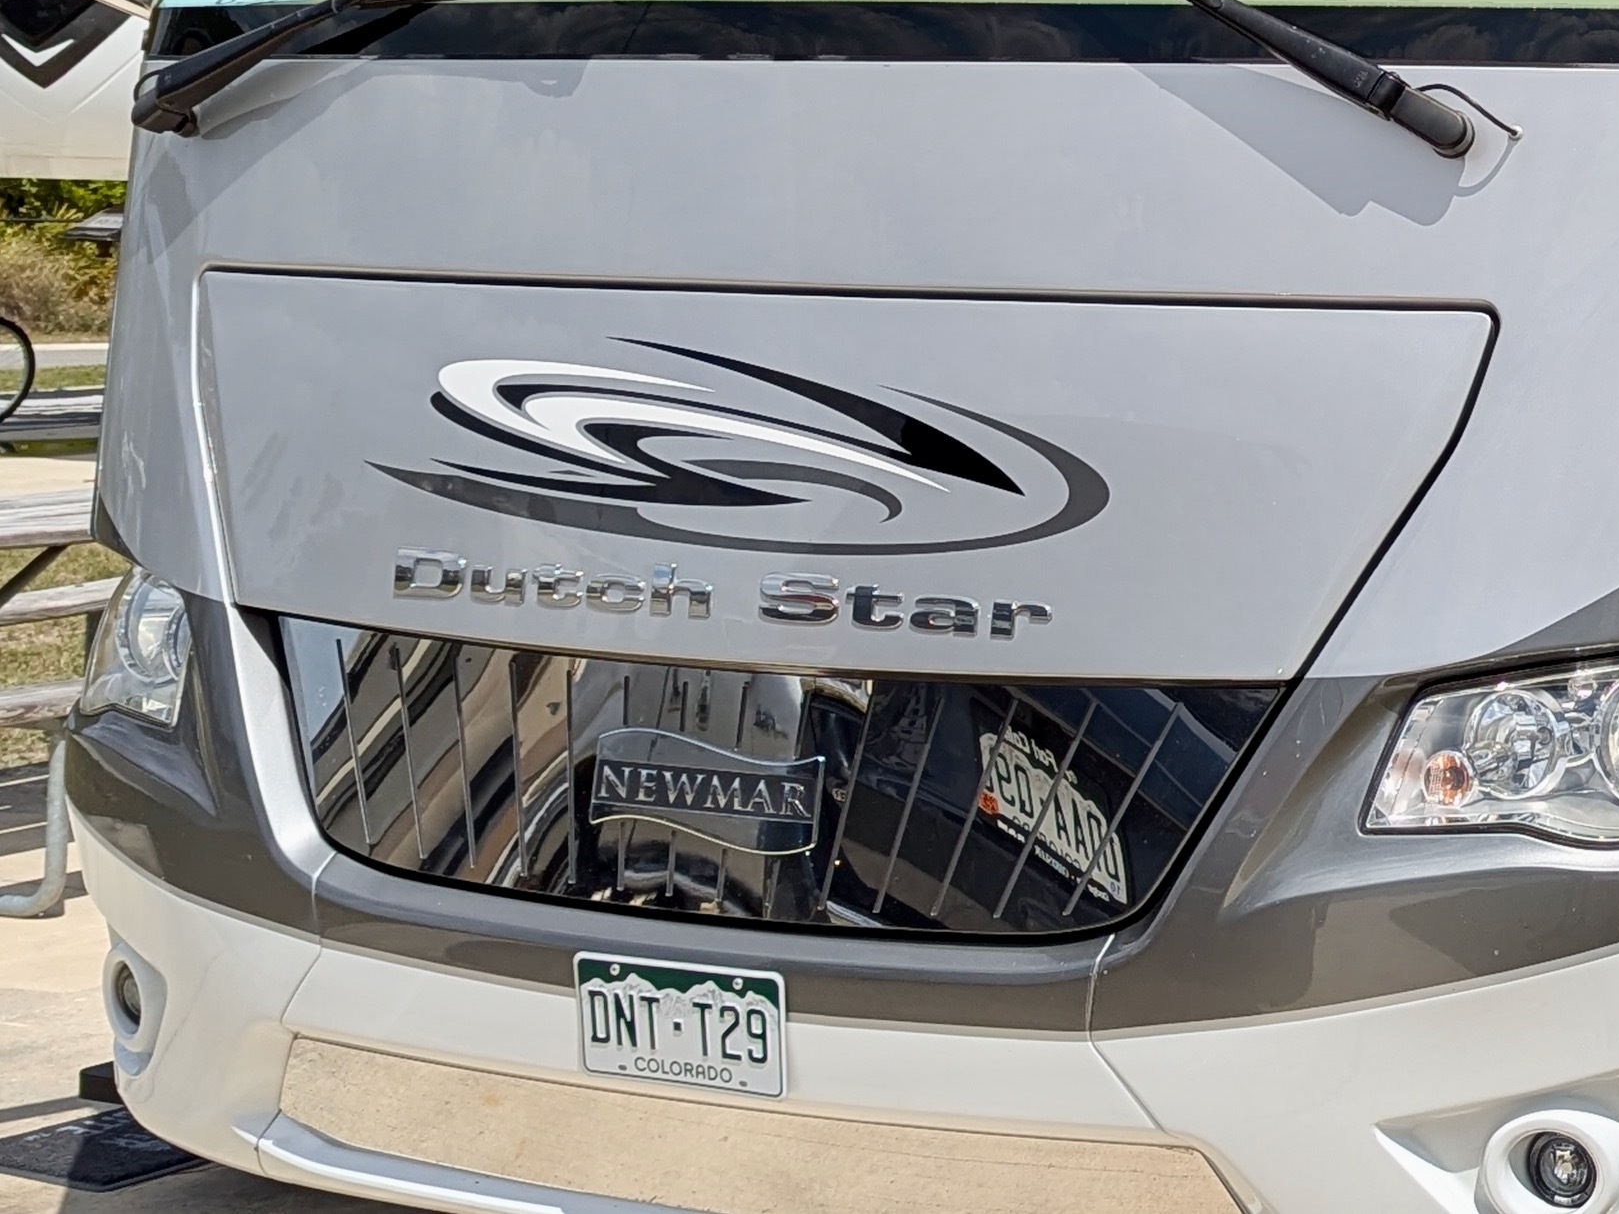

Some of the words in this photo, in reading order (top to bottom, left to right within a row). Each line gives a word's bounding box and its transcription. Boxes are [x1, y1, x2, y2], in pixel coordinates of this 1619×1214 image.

[393, 547, 714, 619] Dutch
[758, 571, 1054, 641] Star
[597, 765, 812, 818] NEWMAR
[634, 1056, 733, 1083] COLORADO
